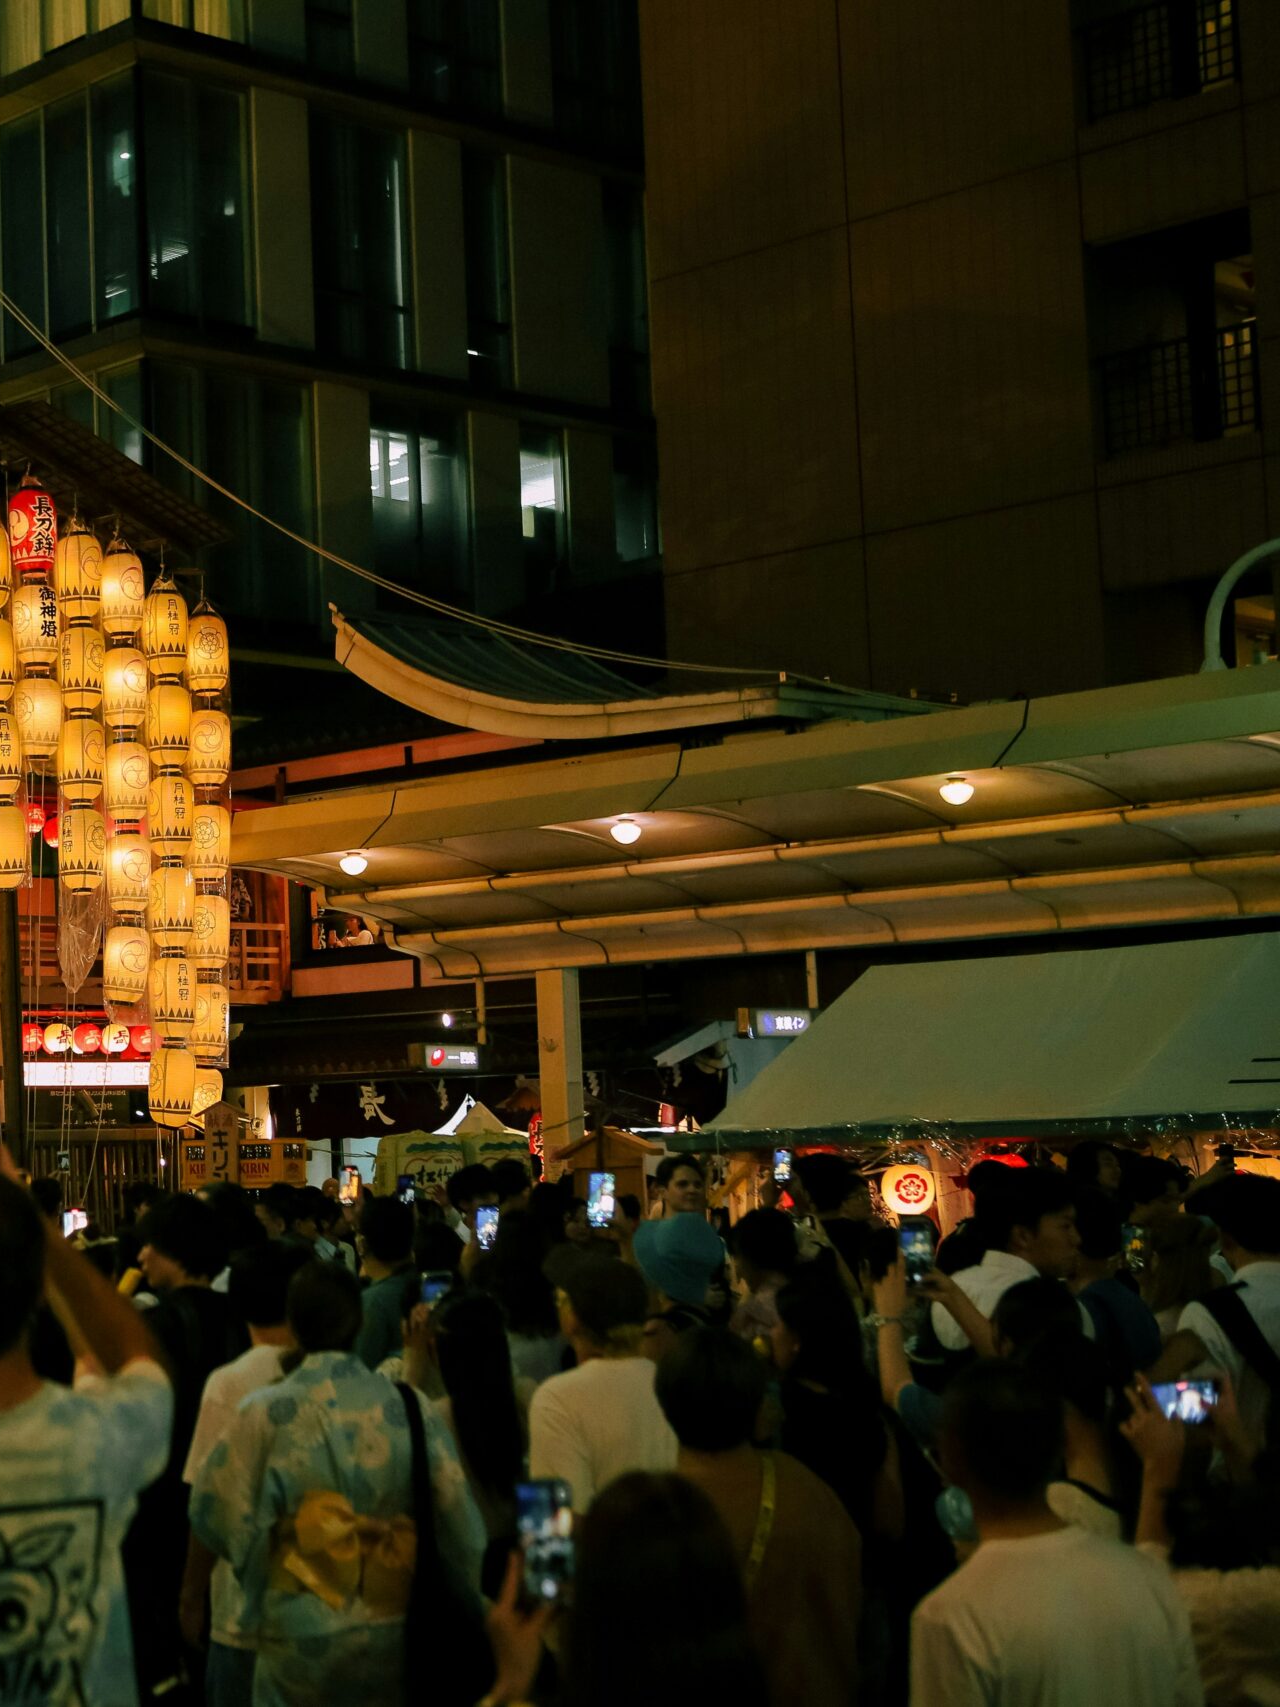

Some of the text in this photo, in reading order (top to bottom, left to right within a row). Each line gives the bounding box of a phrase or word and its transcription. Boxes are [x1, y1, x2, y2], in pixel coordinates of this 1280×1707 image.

[31, 496, 55, 555] 長刀鉾
[239, 1162, 269, 1173] KIRIN
[416, 1165, 452, 1186] 松竹
